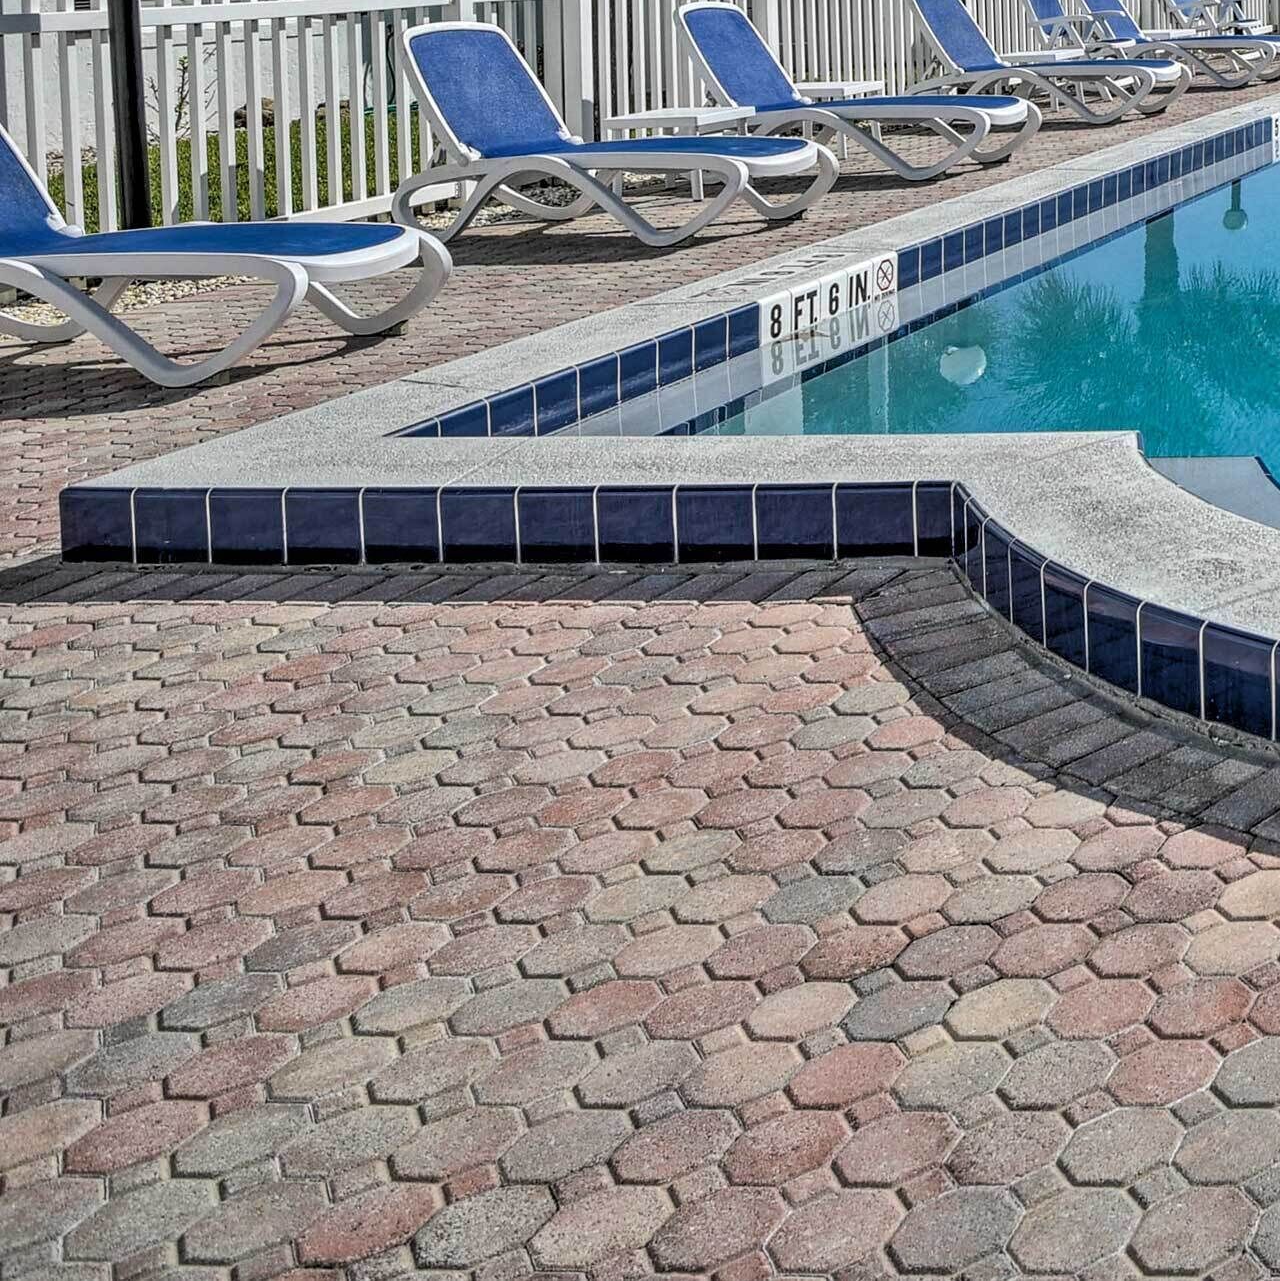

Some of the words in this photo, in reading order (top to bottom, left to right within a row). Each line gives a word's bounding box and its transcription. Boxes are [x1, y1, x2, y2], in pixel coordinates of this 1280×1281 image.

[770, 303, 782, 339] 8
[794, 289, 818, 331] FT.
[828, 282, 840, 316] 6
[848, 270, 871, 309] IN.
